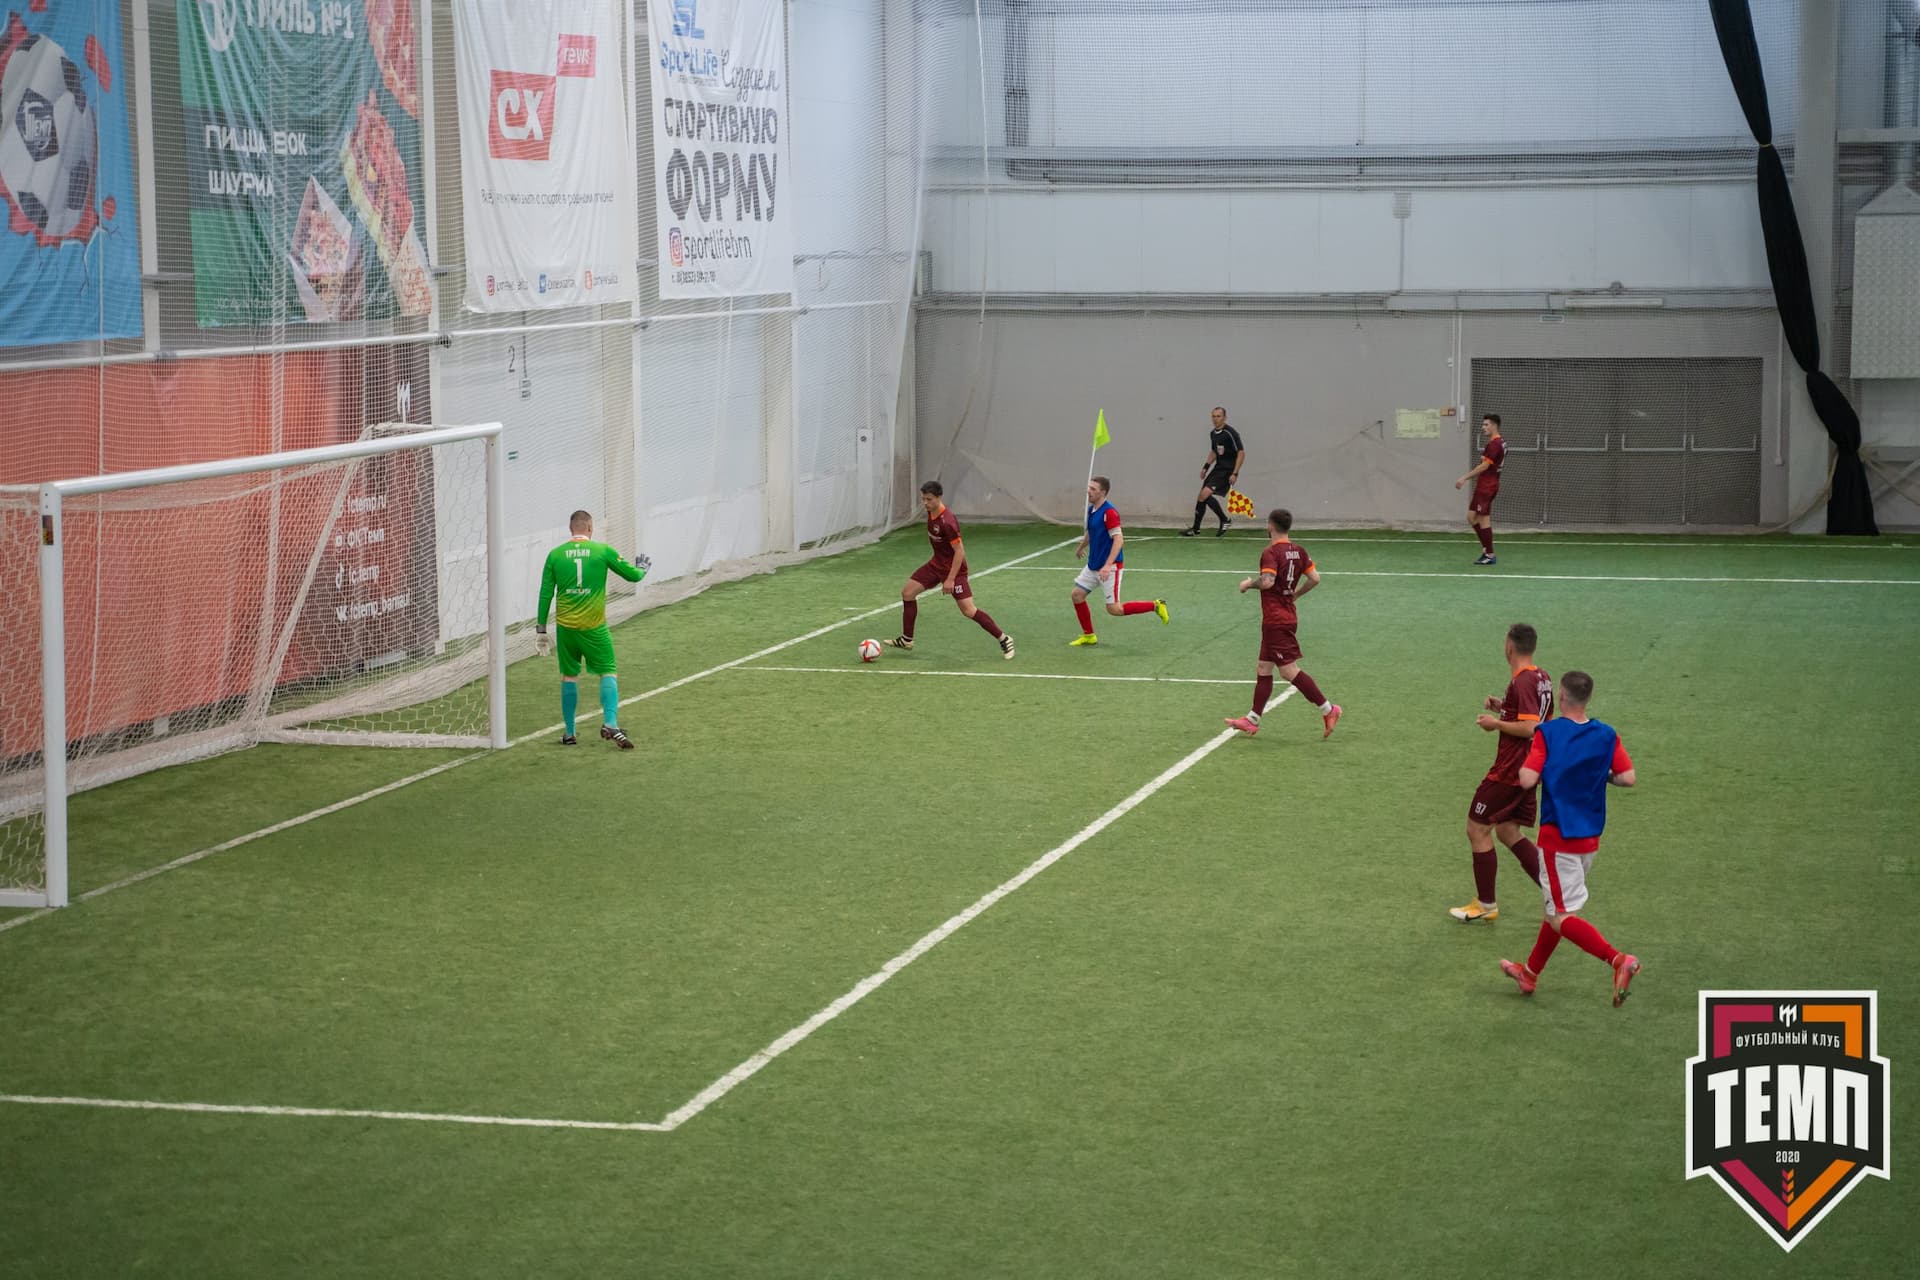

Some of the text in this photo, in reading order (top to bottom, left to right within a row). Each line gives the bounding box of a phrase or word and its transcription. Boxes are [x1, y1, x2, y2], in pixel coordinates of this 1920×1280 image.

[664, 97, 778, 145] СПОРТИВНУЮ
[205, 125, 268, 158] ПИЦЦА
[665, 147, 778, 223] ФОРМУ
[573, 558, 583, 588] 1
[1286, 560, 1295, 589] 4
[1474, 802, 1488, 815] 97
